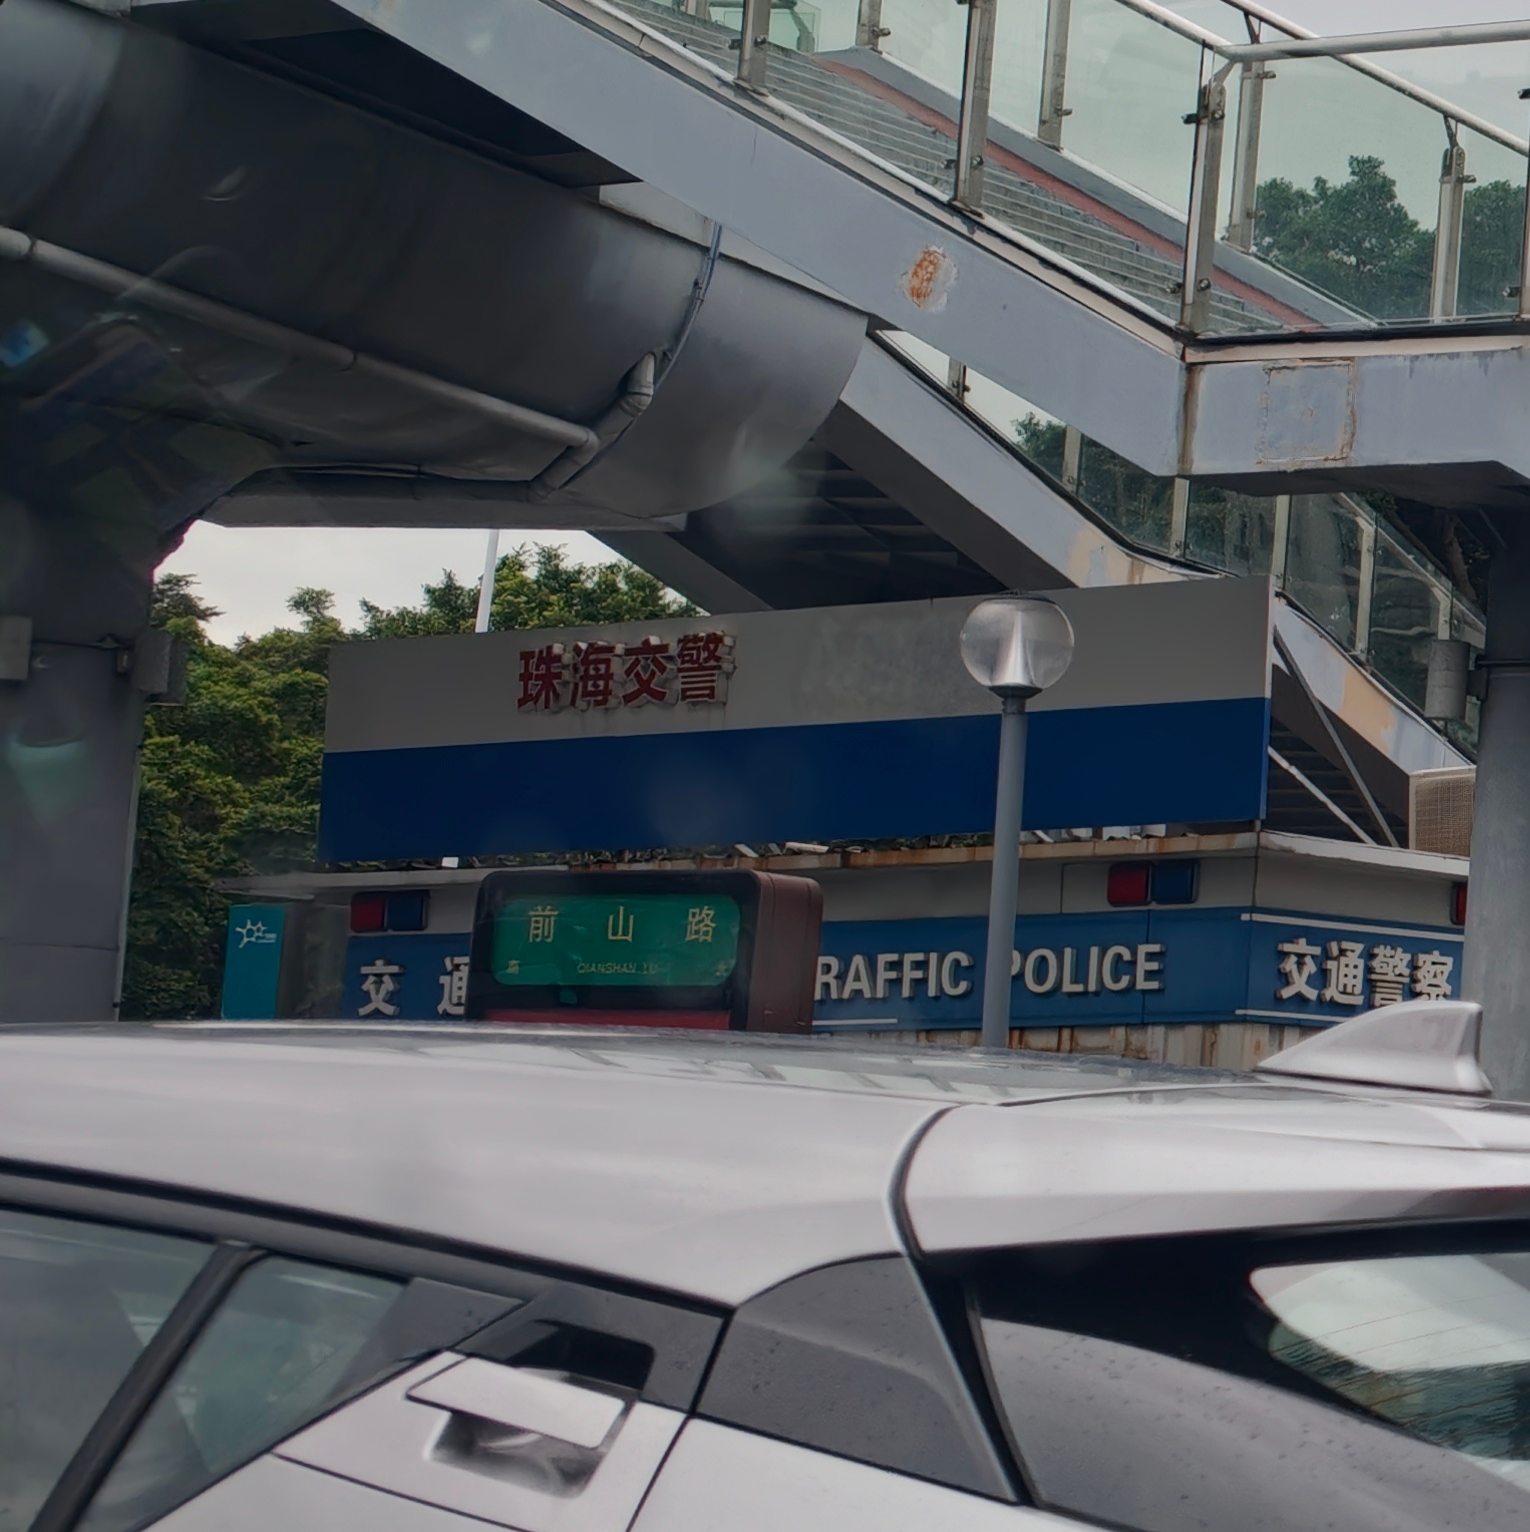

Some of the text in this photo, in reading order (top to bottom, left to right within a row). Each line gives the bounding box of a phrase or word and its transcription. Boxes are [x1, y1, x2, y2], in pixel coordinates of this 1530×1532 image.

[517, 632, 736, 710] 珠海交警
[527, 906, 717, 944] 前山路
[357, 957, 469, 1016] 交通
[814, 950, 974, 1003] RAFFIC
[1276, 936, 1454, 1005] 交通警察
